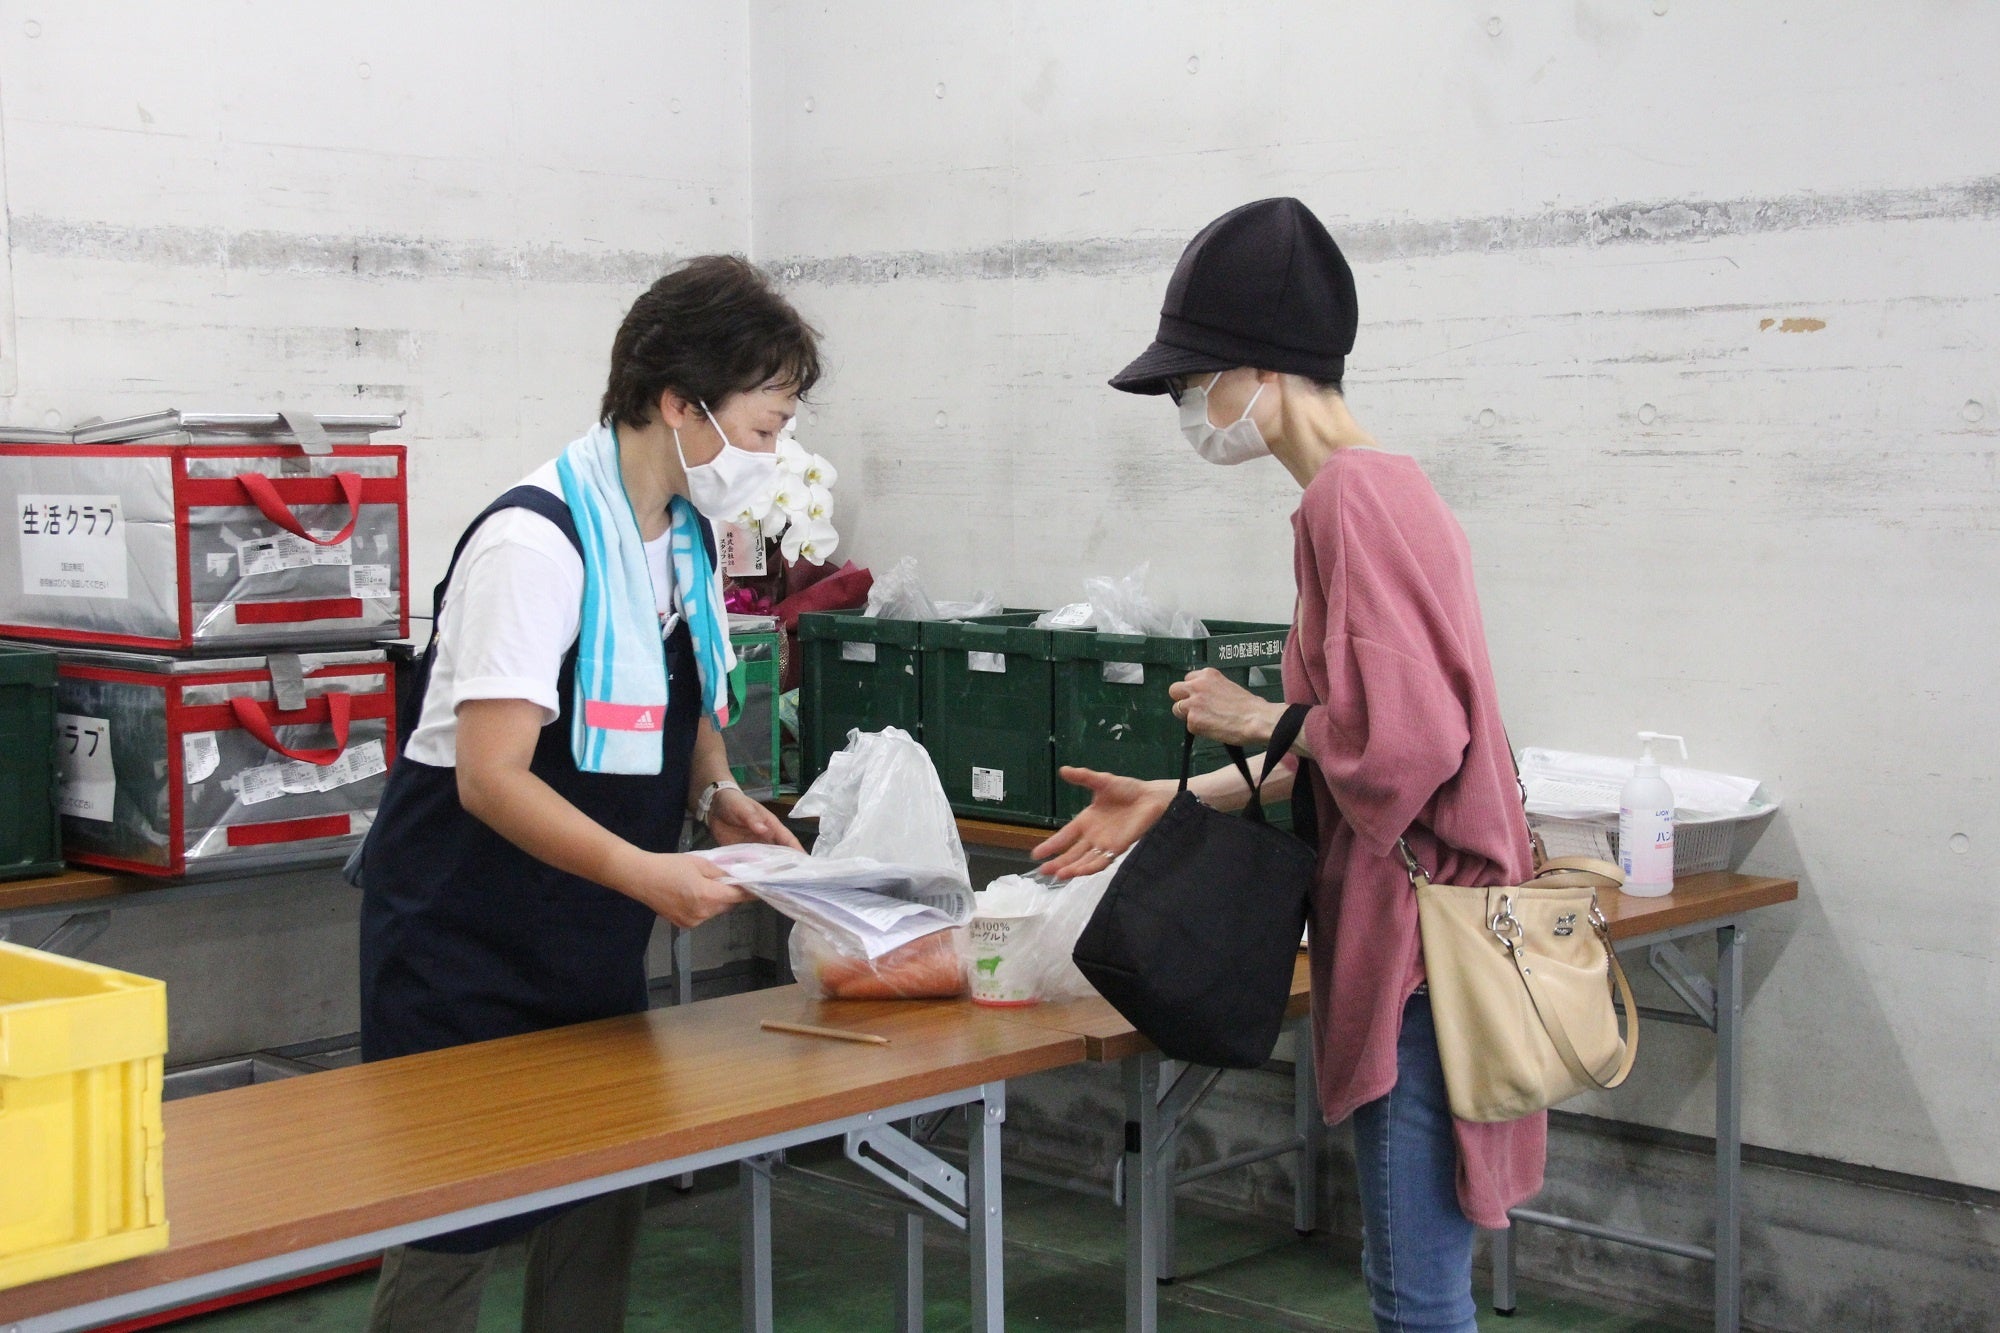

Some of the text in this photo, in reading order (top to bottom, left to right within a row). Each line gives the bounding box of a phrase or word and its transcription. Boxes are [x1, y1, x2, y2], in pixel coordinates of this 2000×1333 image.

[23, 503, 118, 536] 生活クラブ
[755, 534, 763, 570] ーション様
[58, 725, 104, 757] ラブ
[1656, 832, 1673, 842] ハン
